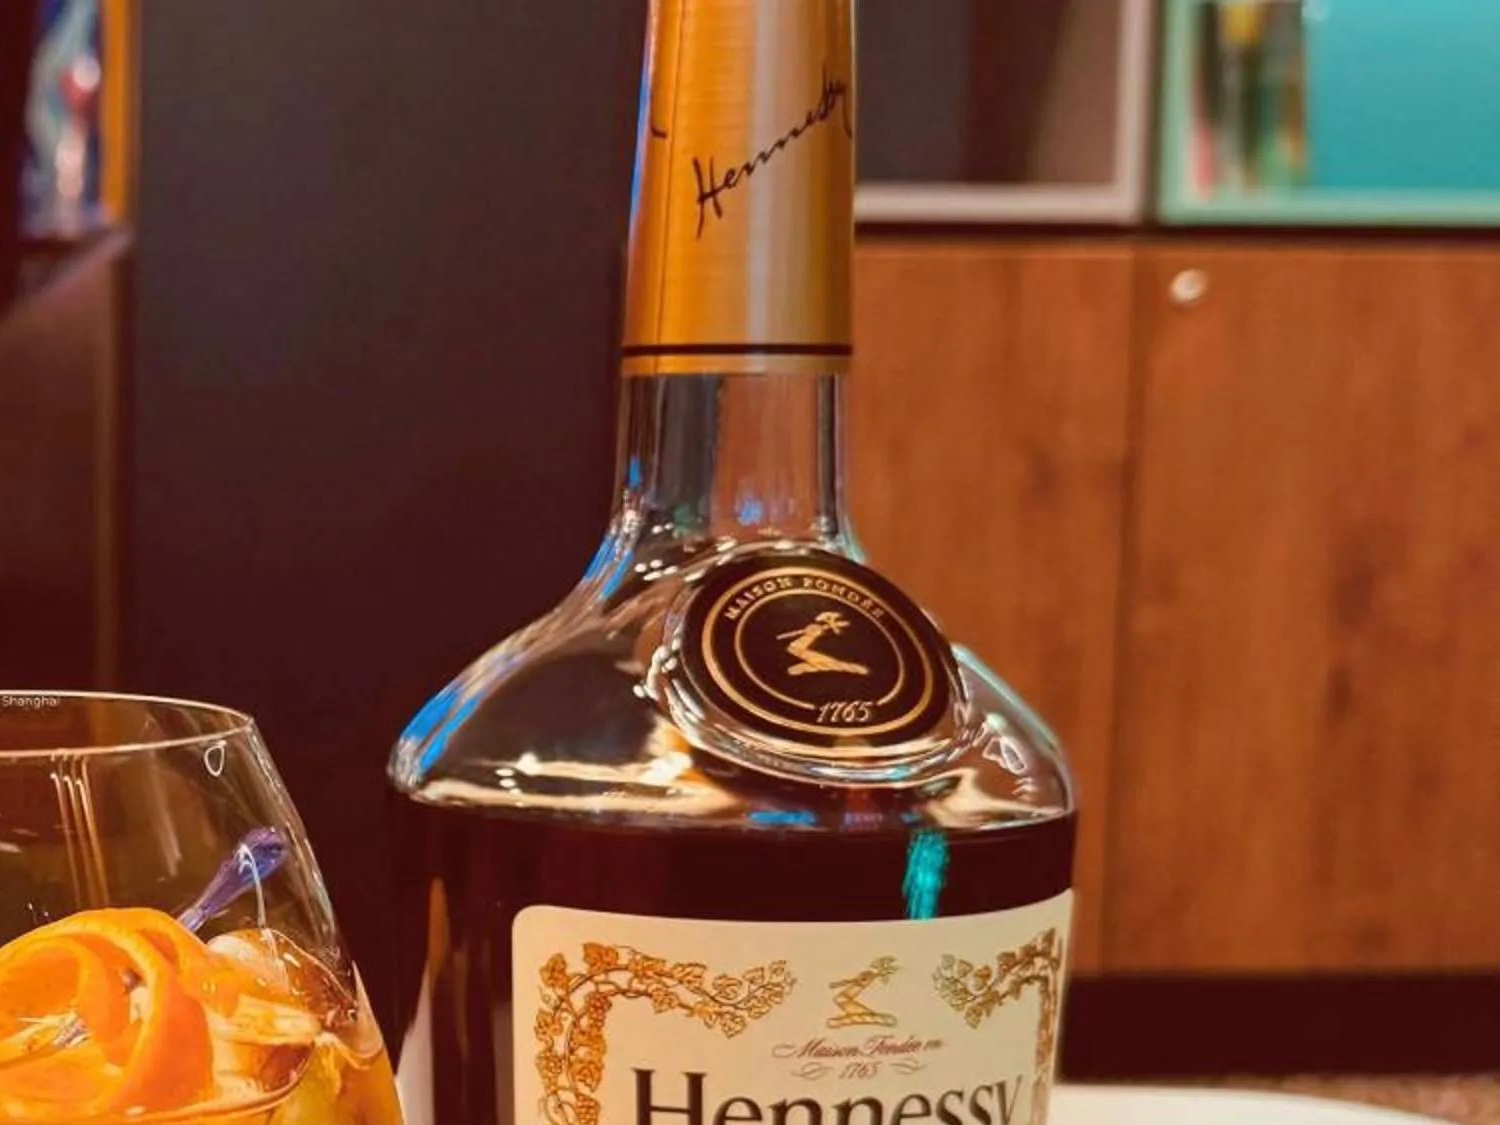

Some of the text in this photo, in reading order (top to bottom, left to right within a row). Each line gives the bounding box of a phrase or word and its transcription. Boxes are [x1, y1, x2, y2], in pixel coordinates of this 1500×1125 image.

[724, 577, 793, 620] MAISON
[816, 701, 874, 724] 1765
[838, 1061, 882, 1081] 1765
